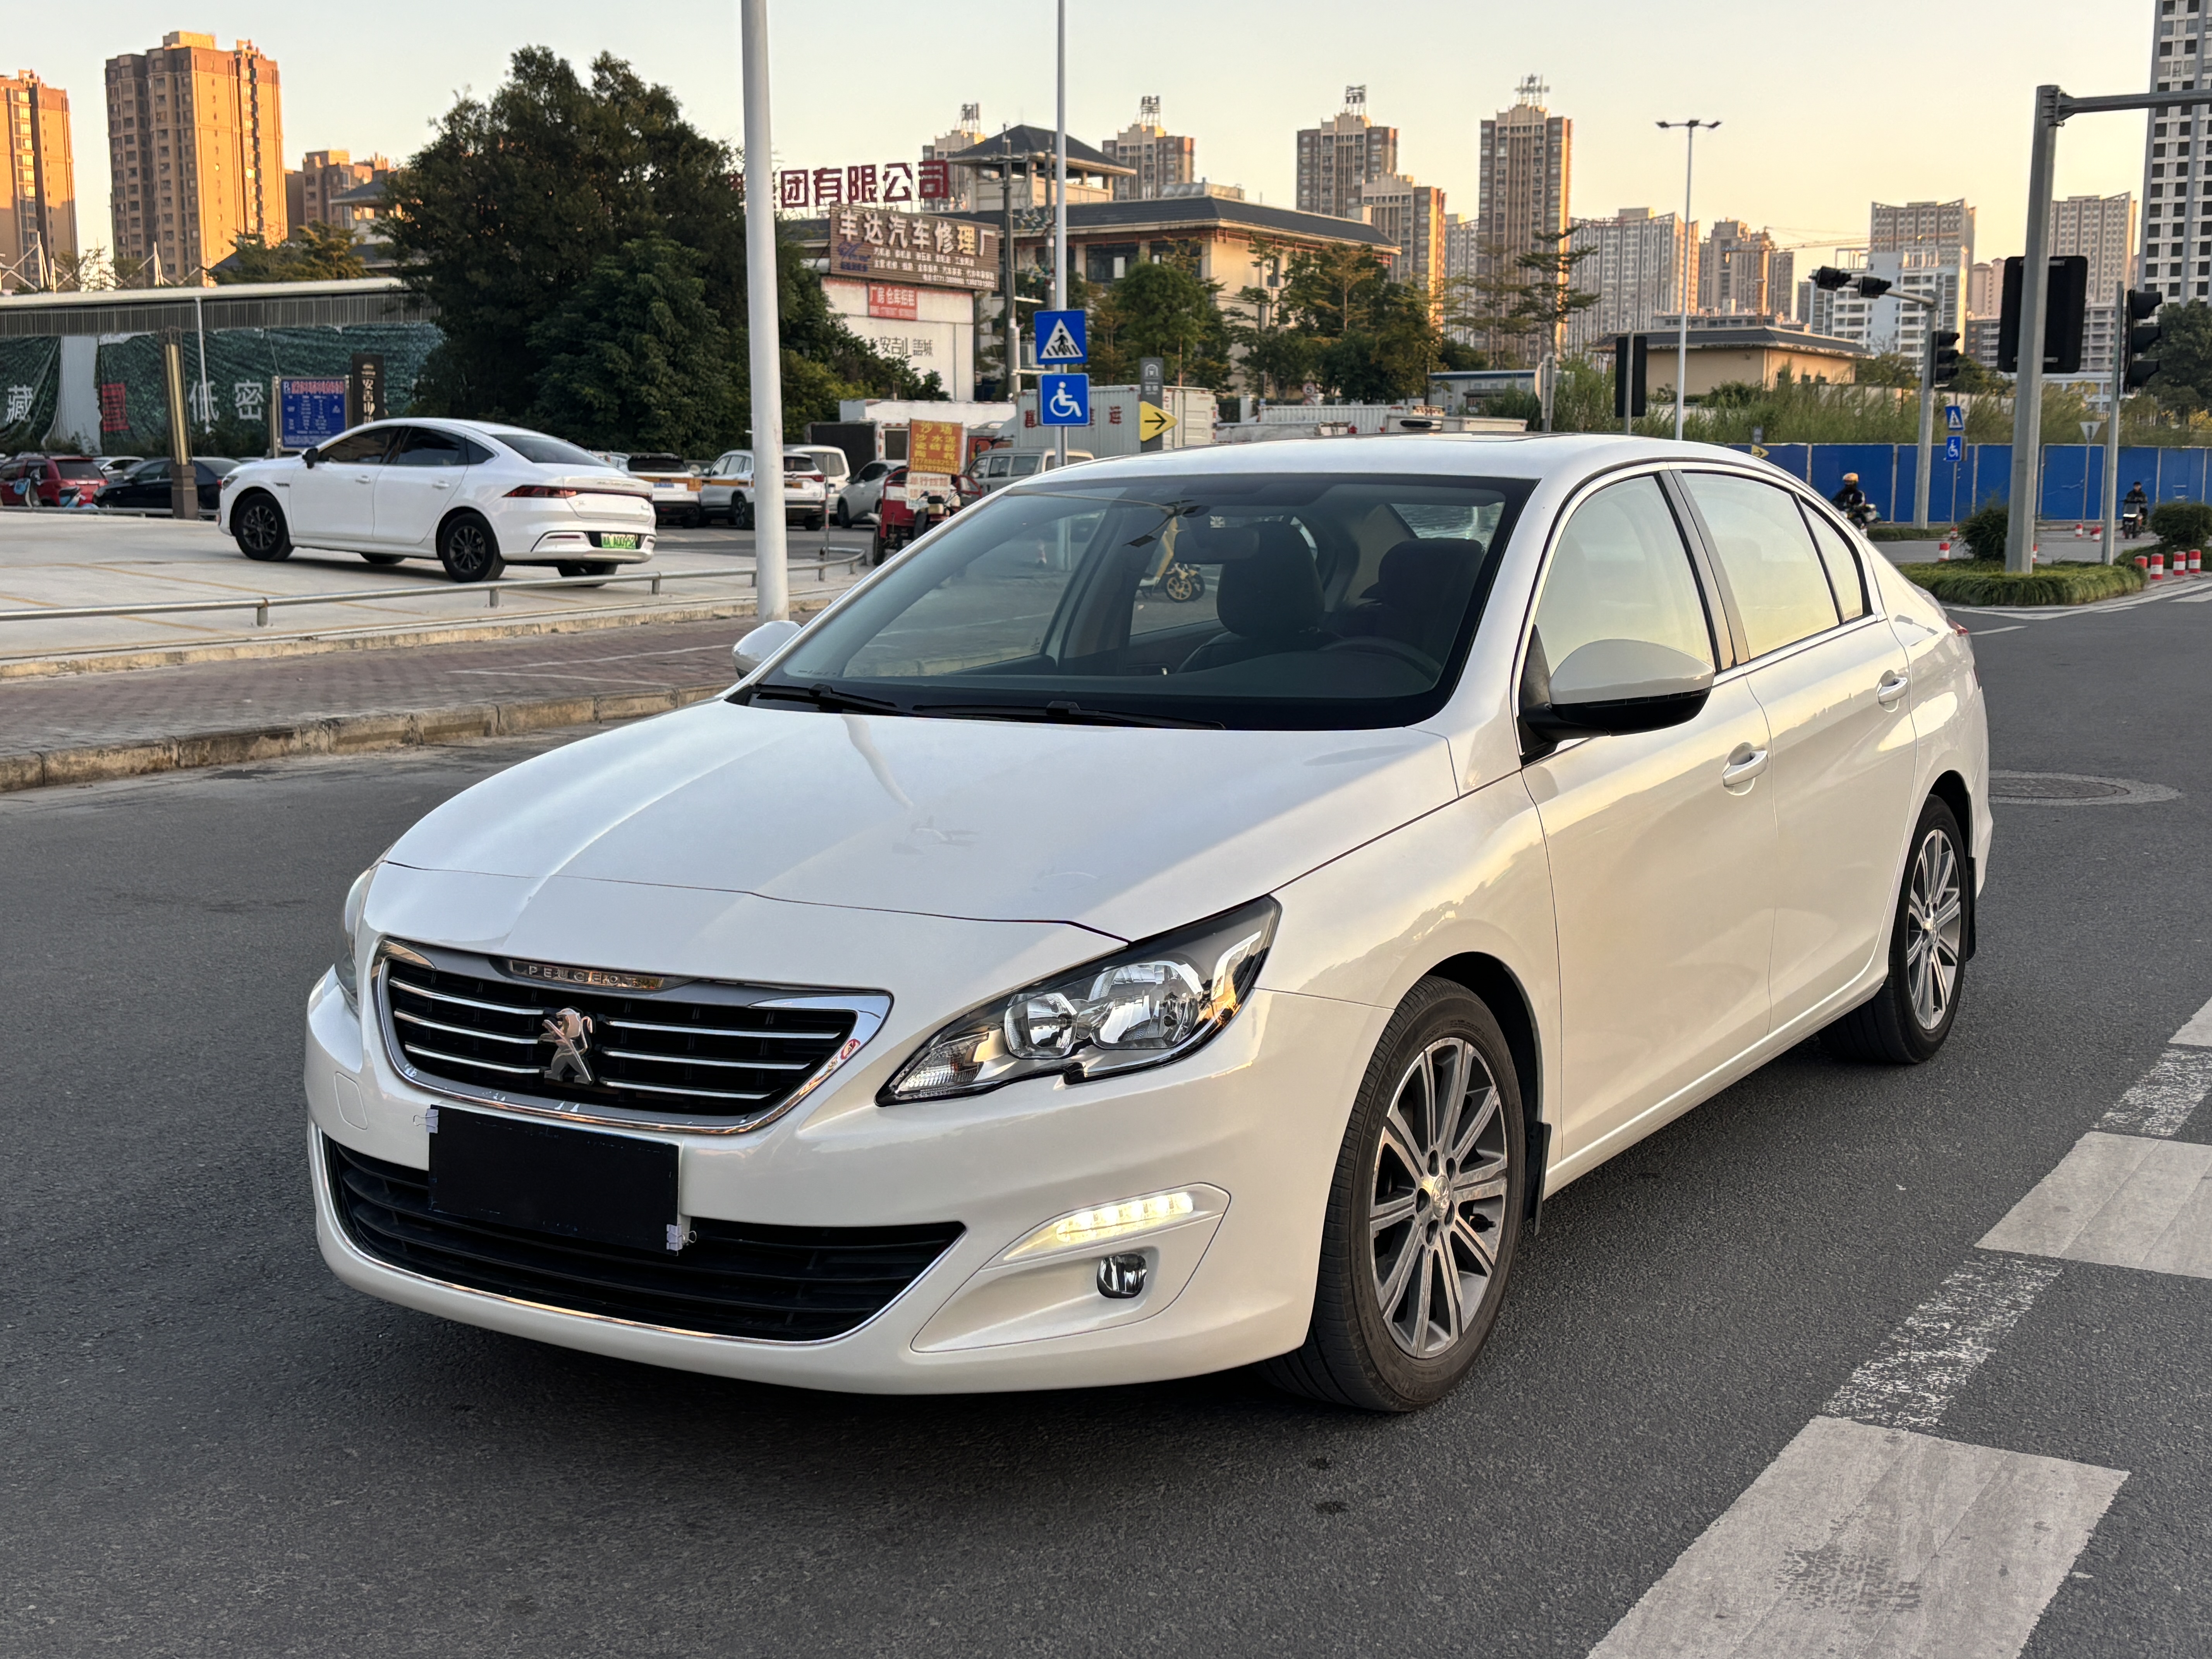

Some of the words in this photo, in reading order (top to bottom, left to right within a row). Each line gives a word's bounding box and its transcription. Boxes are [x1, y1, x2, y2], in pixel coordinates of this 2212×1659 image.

[839, 209, 996, 256] 丰达汽车修理厂
